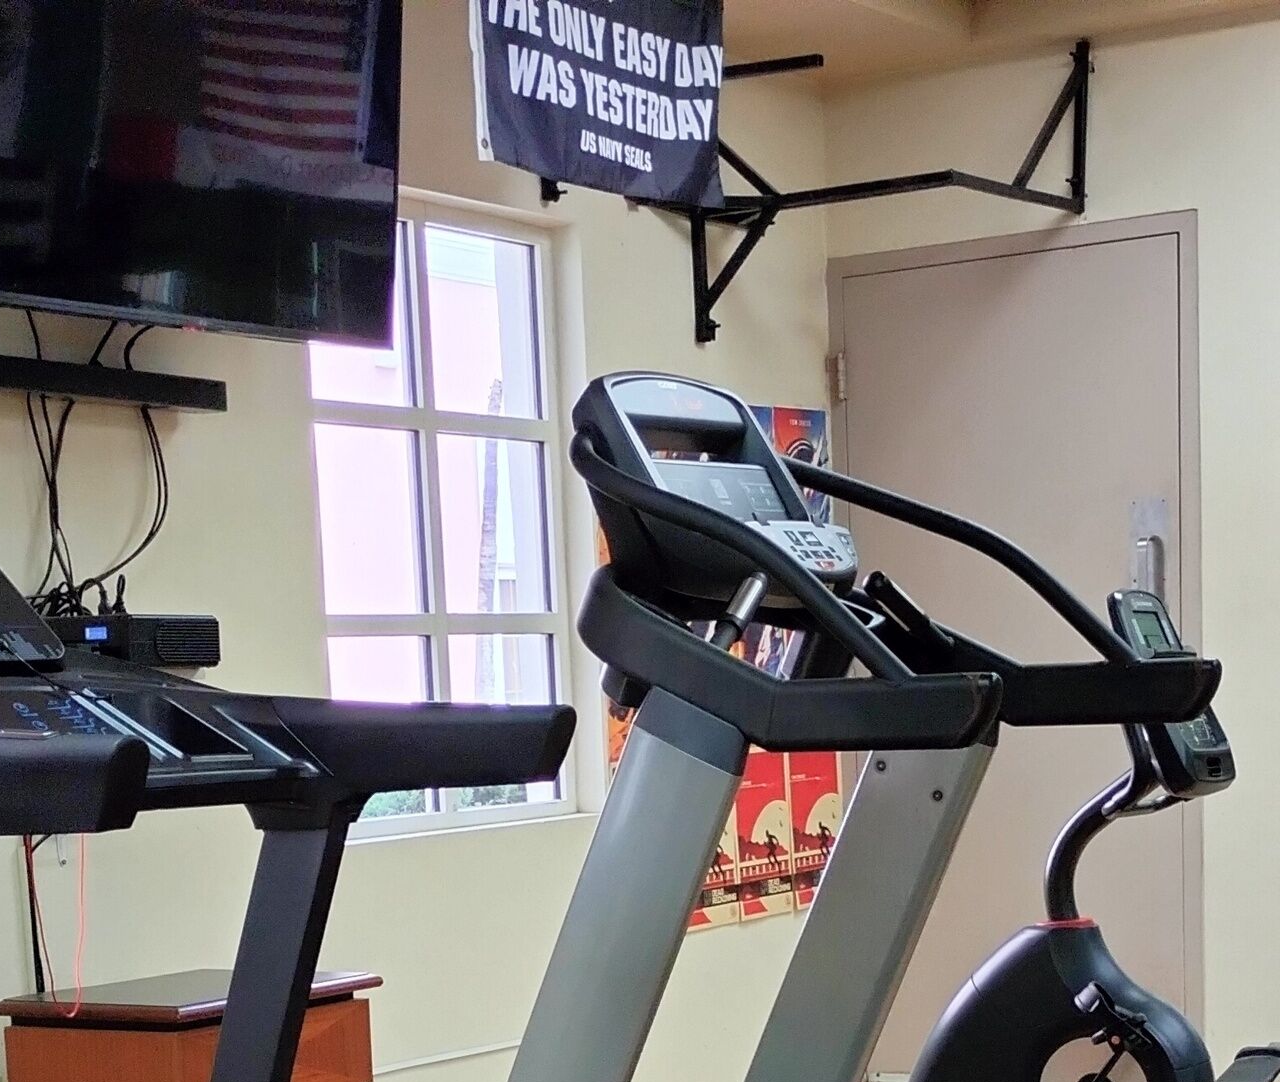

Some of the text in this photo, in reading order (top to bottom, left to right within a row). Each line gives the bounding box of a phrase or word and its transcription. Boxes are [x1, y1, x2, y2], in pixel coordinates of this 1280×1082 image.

[488, 0, 723, 88] THE ONLY EASY DAY
[508, 44, 713, 141] WAS YESTERDAY
[581, 129, 652, 172] US NAVY SEALS
